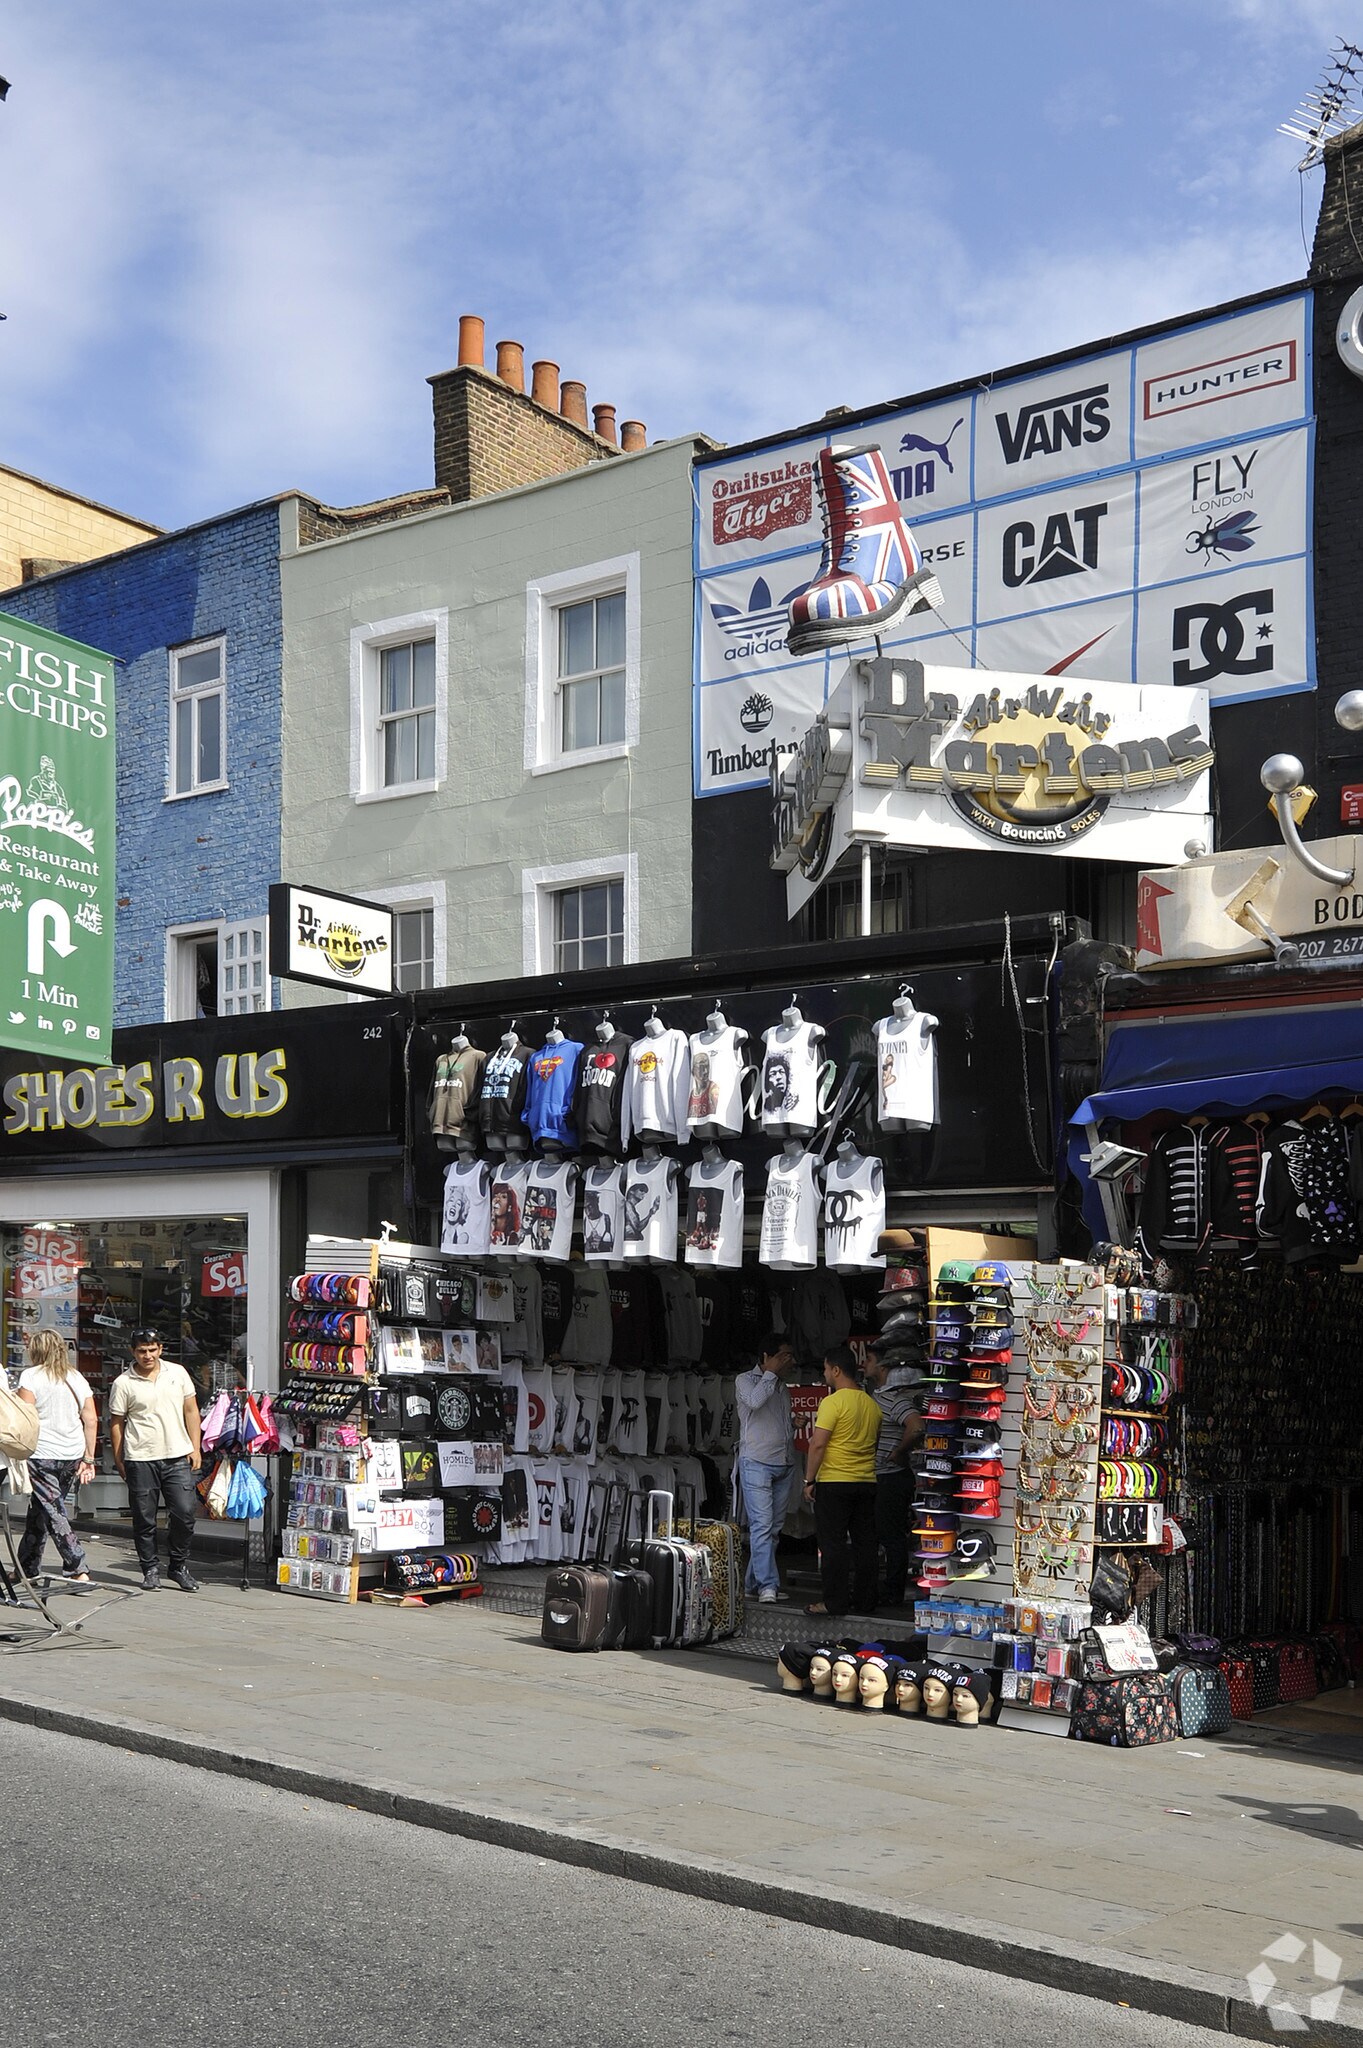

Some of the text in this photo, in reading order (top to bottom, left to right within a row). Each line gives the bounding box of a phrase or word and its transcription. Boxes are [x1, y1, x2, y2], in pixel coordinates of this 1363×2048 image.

[1157, 359, 1283, 402] HUNTER
[995, 384, 1110, 465] VANS
[712, 461, 812, 499] Onitsuka
[1192, 449, 1259, 501] FLY
[723, 487, 800, 534] Tiger
[1191, 489, 1254, 514] LONDON
[1002, 503, 1109, 588] CAT
[1172, 589, 1274, 686] DC
[6, 682, 108, 739] CHIPS
[963, 684, 1112, 739] AirWair
[859, 715, 1215, 796] Martens
[971, 808, 1101, 841] WITH Bouncing SOLES
[0, 834, 100, 877] Restaurant
[0, 859, 98, 898] & Take Away
[298, 904, 321, 929] Dr.
[326, 921, 362, 937] AirWair
[297, 925, 389, 957] Martens
[21, 979, 79, 1009] 1 Min
[363, 1026, 382, 1039] 242
[3, 1048, 289, 1135] SHOES R US
[582, 1067, 616, 1088] LONDON
[203, 1252, 232, 1265] Clearance
[20, 1259, 68, 1294] Sale
[436, 1280, 462, 1288] CHICAGO
[439, 1287, 457, 1295] BULLS
[100, 1316, 116, 1326] OPEN
[440, 1387, 470, 1410] STARBUCKS
[443, 1416, 466, 1429] COFFEE
[443, 1455, 474, 1465] HOMIES
[414, 1521, 434, 1531] BOY
